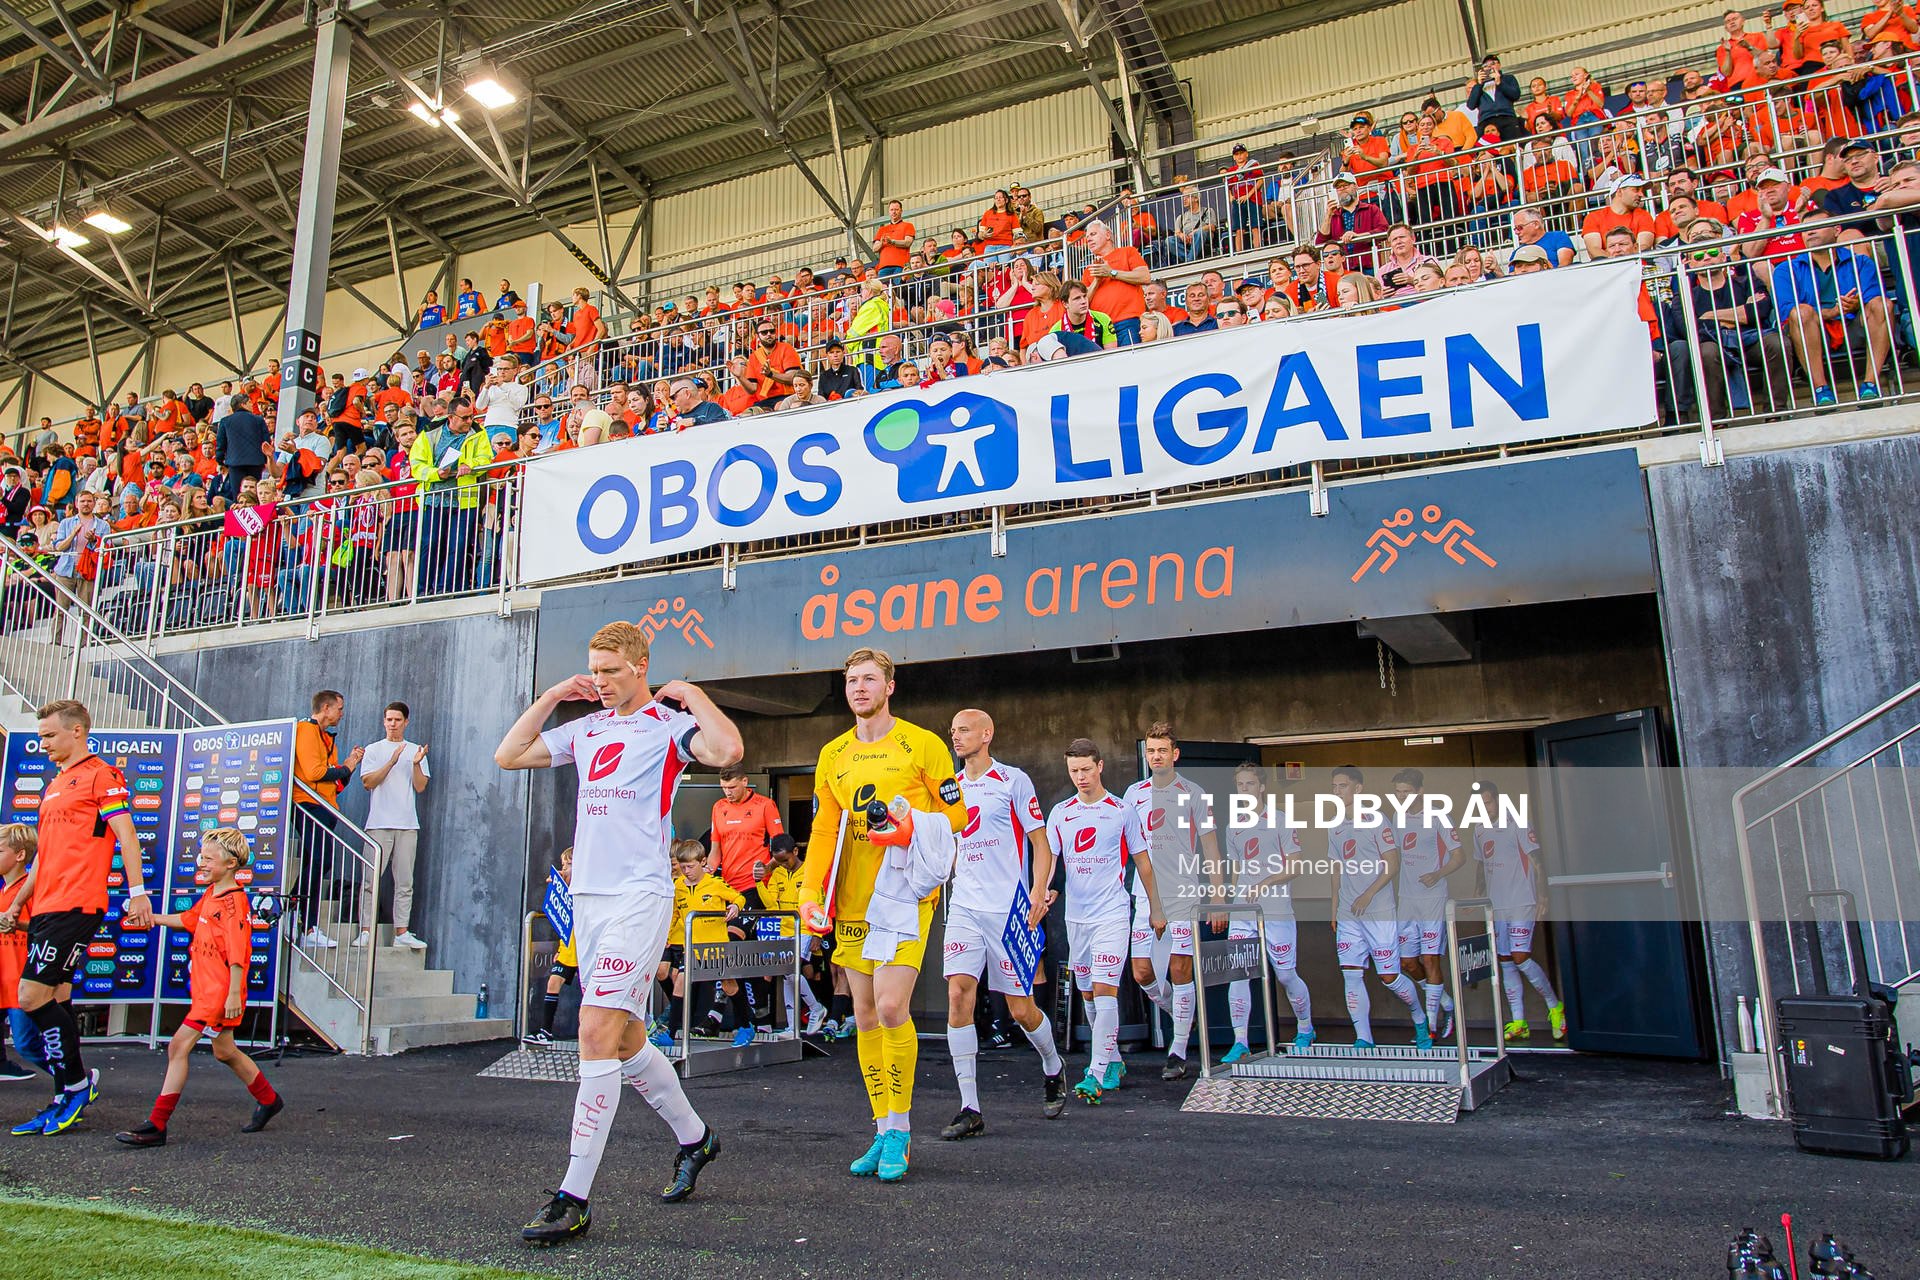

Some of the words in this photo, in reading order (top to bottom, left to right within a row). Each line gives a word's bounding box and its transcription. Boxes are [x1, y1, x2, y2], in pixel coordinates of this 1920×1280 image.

[288, 336, 297, 351] D
[306, 336, 316, 353] D
[285, 366, 294, 381] C
[304, 368, 314, 383] C
[576, 432, 842, 555] OBOS
[1050, 322, 1549, 483] LIGAEN
[801, 564, 1003, 641] åsane
[1025, 545, 1235, 618] arena
[102, 741, 163, 754] LIGAEN
[193, 737, 224, 752] OBOS
[242, 731, 282, 748] LIGAEN
[900, 740, 912, 754] BOB
[586, 803, 608, 816] Vest
[136, 832, 156, 840] oop
[967, 853, 984, 862] Vest
[1076, 866, 1092, 874] Vest
[549, 892, 571, 929] KOKER
[1010, 914, 1036, 974] STEKER
[1094, 954, 1122, 964] LERØY
[91, 961, 110, 974] DNB
